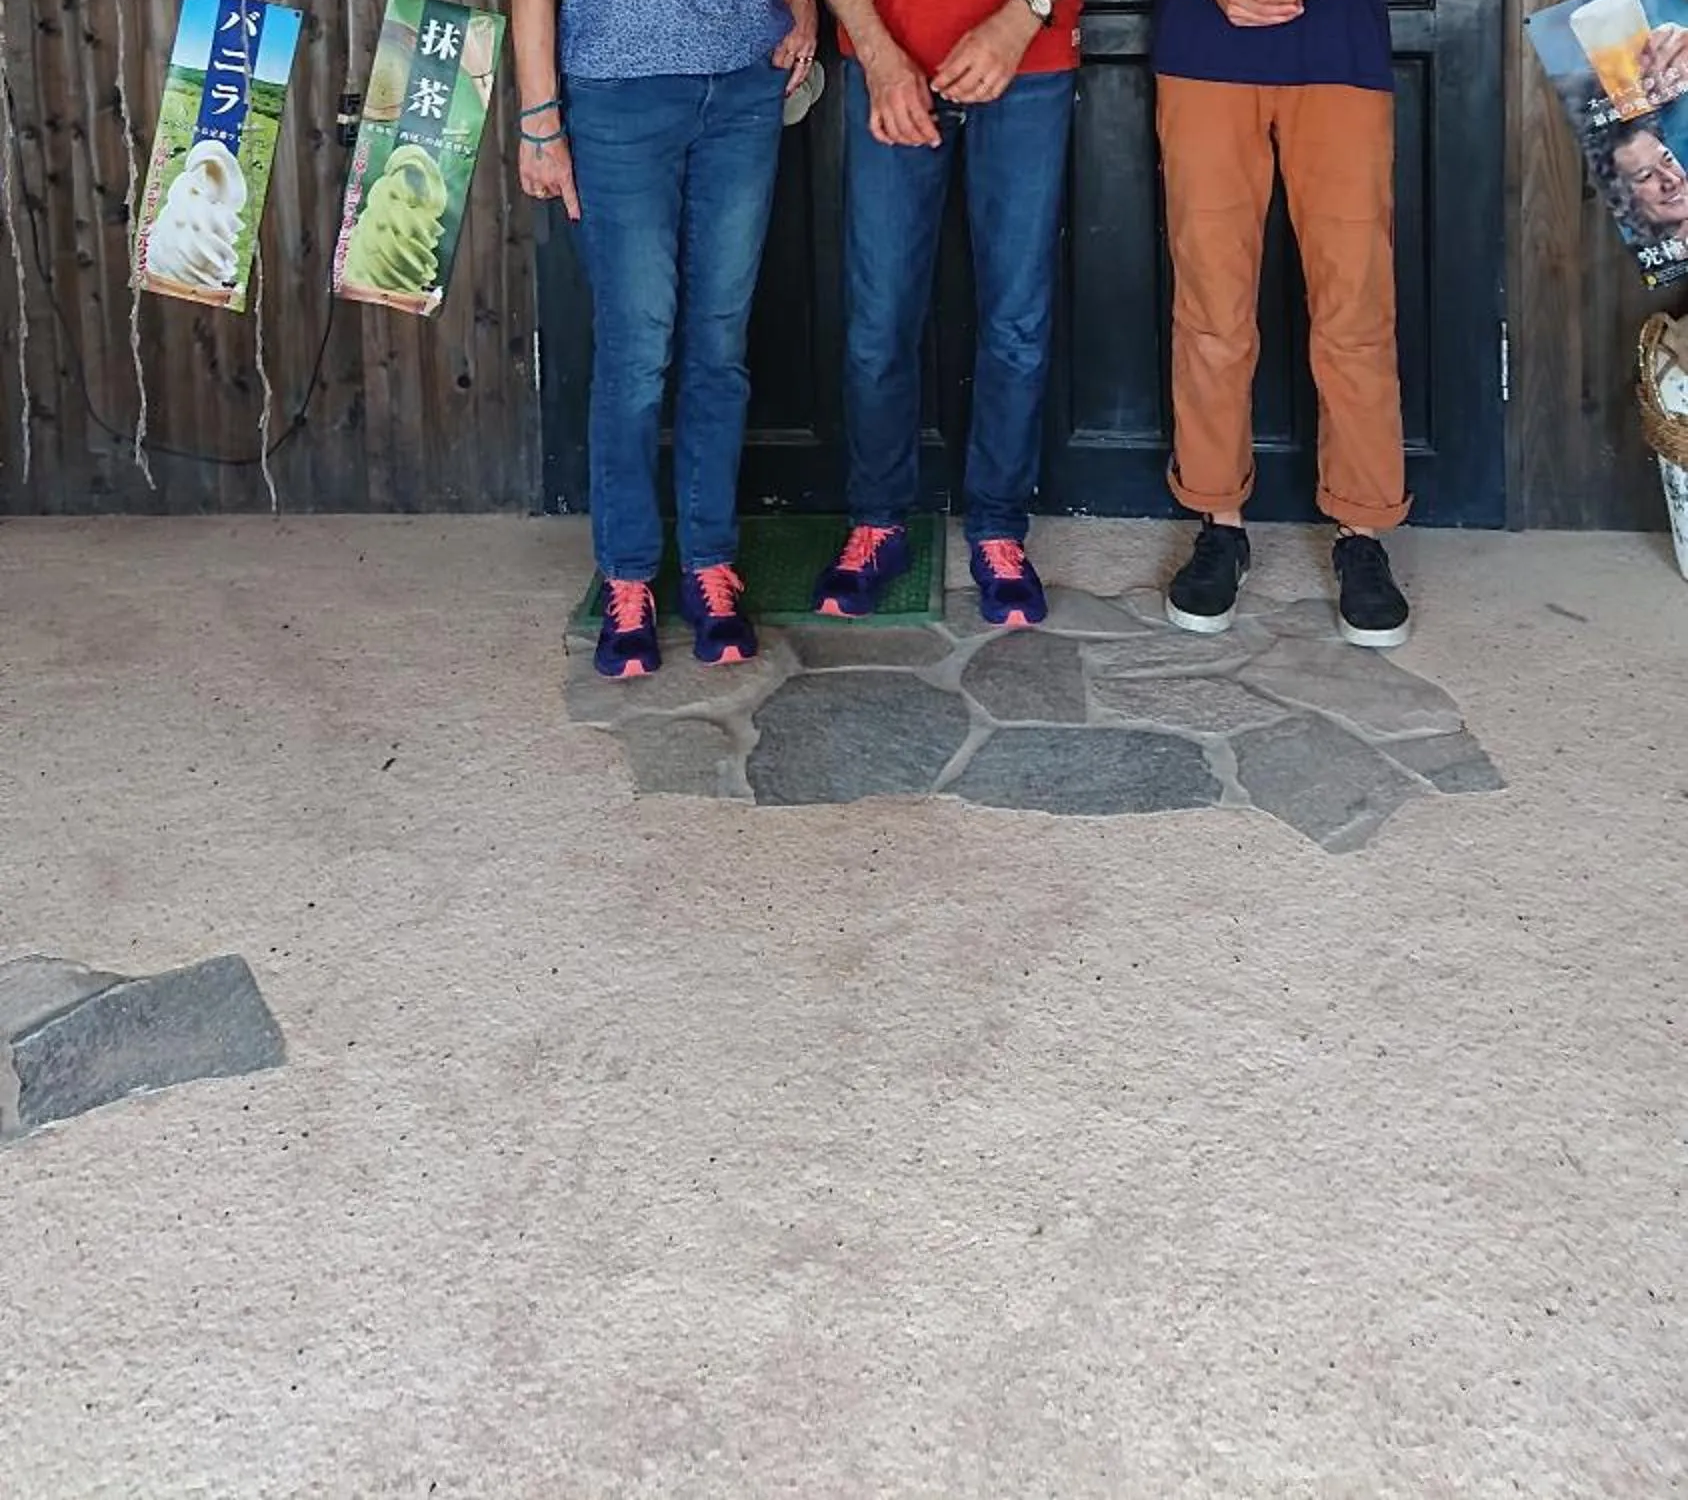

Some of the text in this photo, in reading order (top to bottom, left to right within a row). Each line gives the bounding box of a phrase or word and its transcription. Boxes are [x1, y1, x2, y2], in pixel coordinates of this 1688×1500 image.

[211, 11, 260, 115] バニラ
[407, 19, 461, 119] 抹茶
